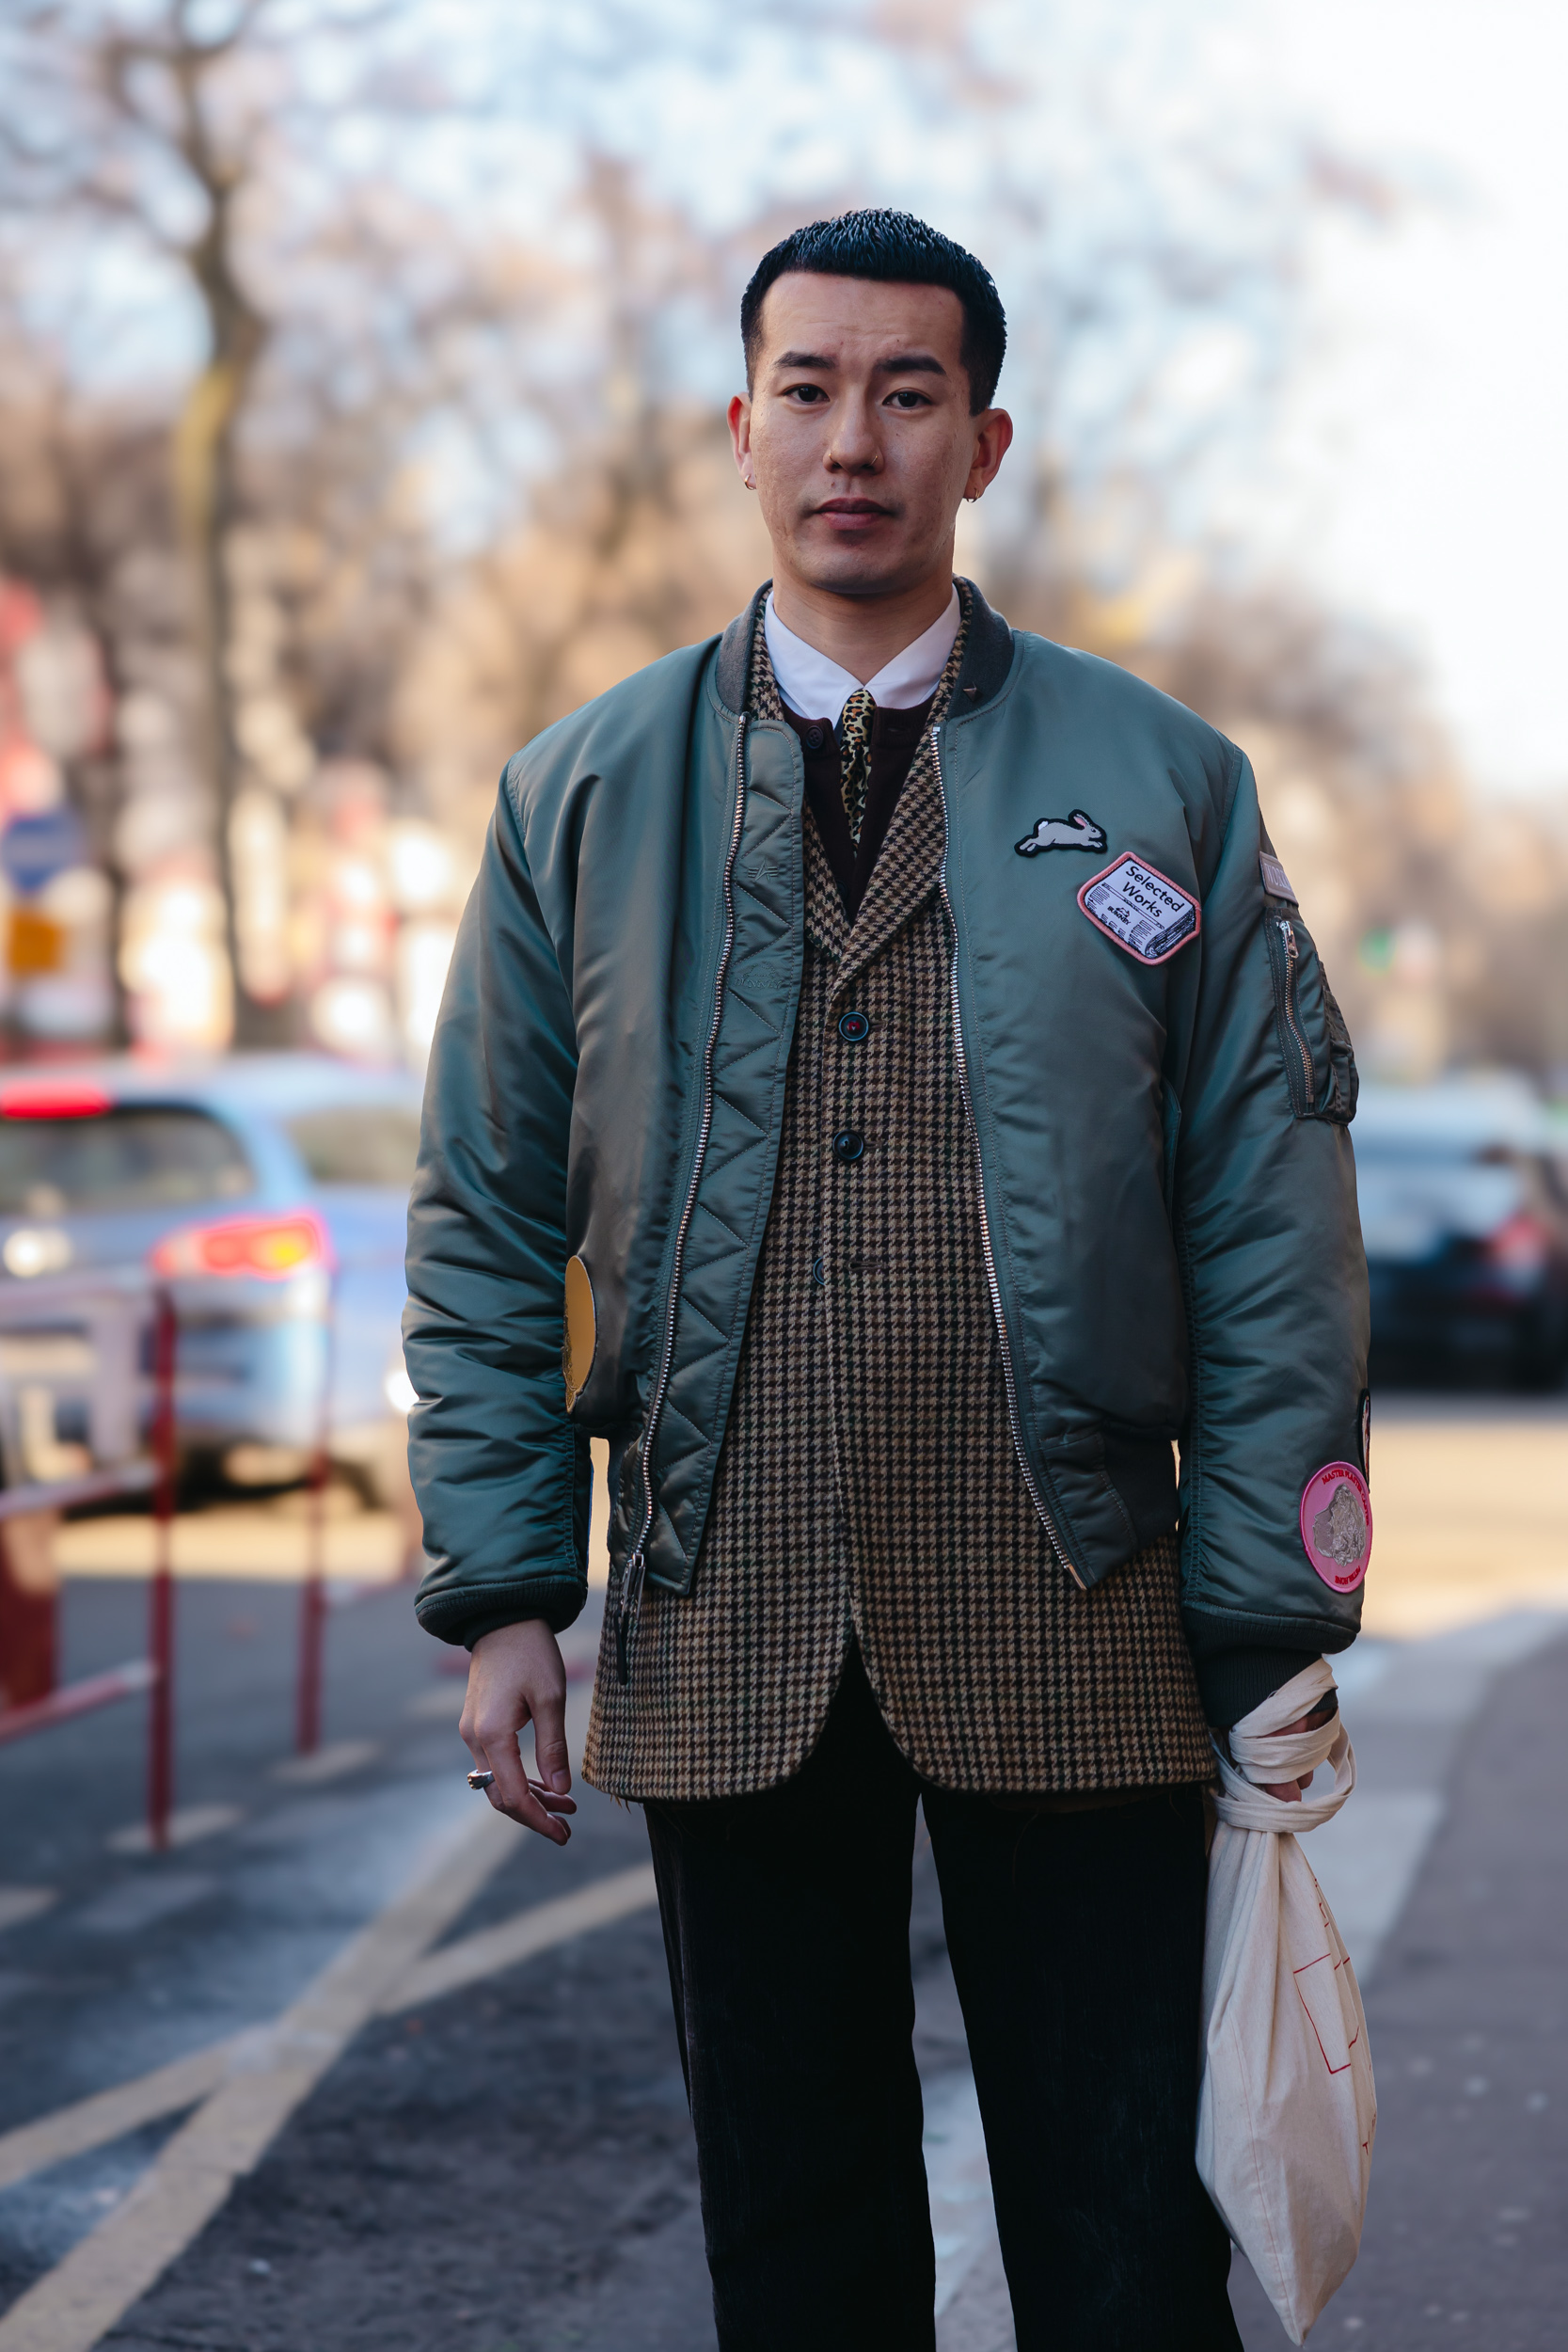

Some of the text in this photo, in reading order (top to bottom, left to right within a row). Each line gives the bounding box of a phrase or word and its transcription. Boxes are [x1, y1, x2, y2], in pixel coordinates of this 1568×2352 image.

[1121, 882, 1163, 918] Works
[1125, 866, 1185, 913] Selected
[1106, 905, 1132, 926] BUNNEY
[1322, 1469, 1344, 1485] MASTER
[1345, 1470, 1362, 1494] PLASTER
